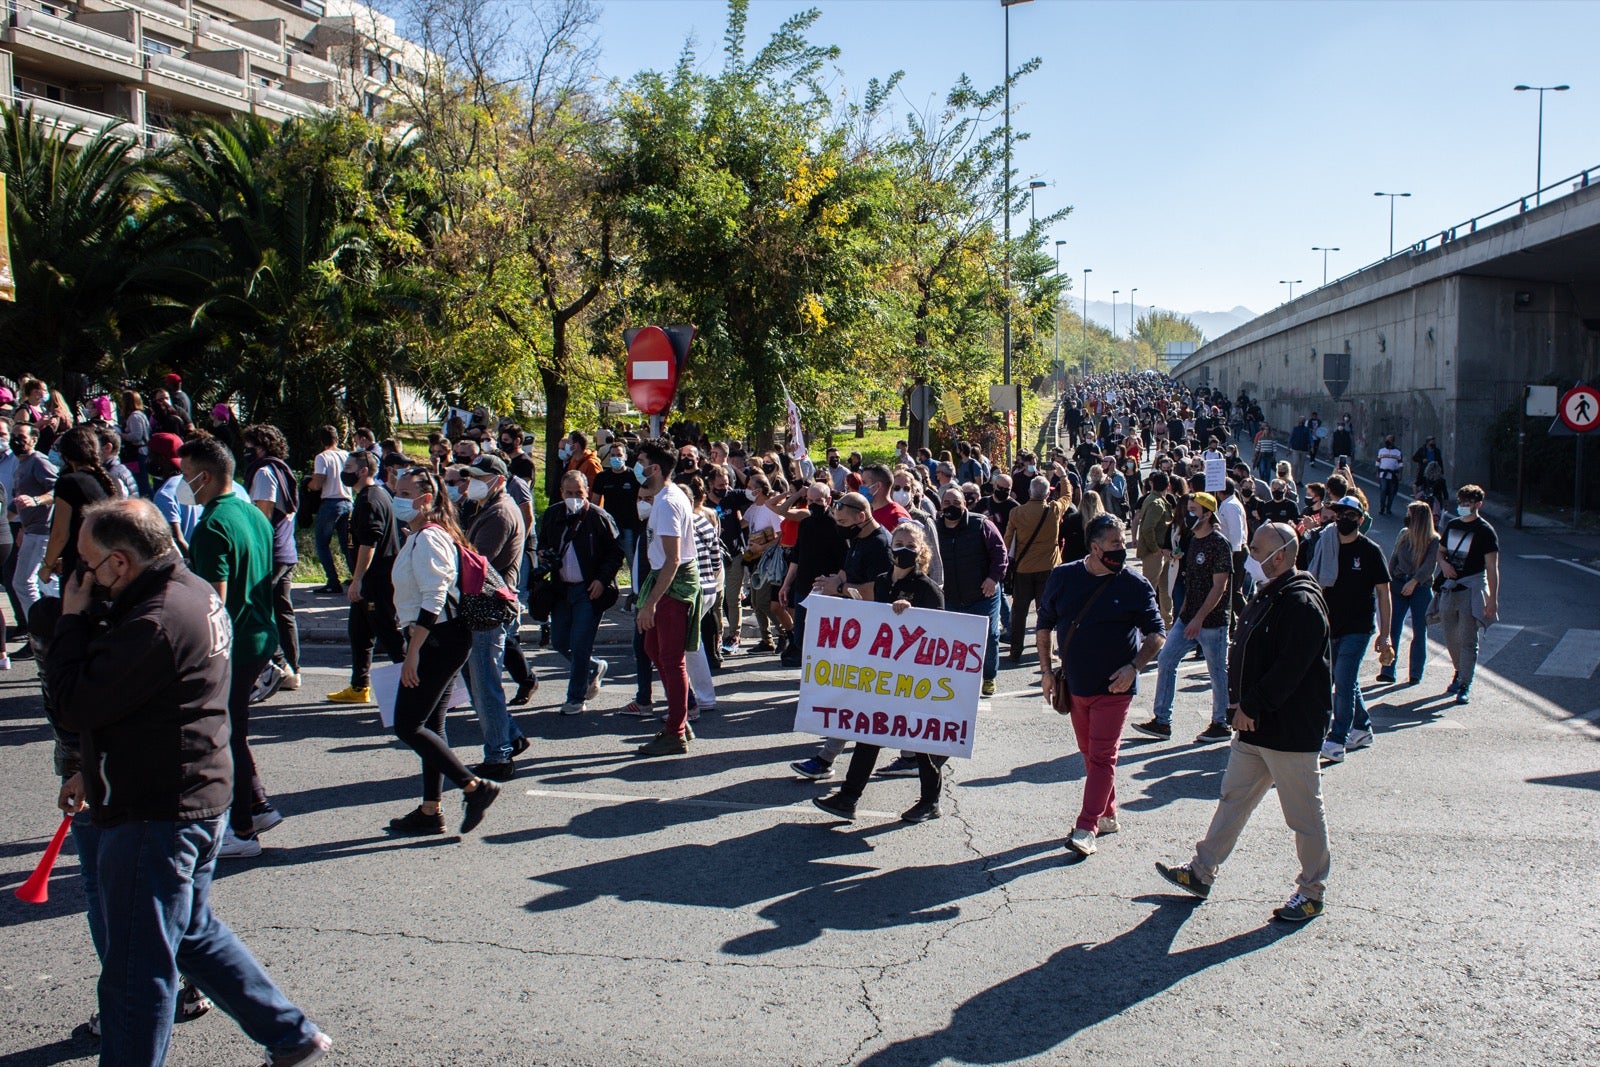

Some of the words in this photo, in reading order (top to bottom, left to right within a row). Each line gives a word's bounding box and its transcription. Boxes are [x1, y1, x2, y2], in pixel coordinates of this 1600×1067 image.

[817, 616, 861, 649] NO
[868, 623, 982, 673] AYUDAS
[804, 656, 955, 700] ¡QUEREMOS
[812, 706, 967, 744] TRABAJAR!
